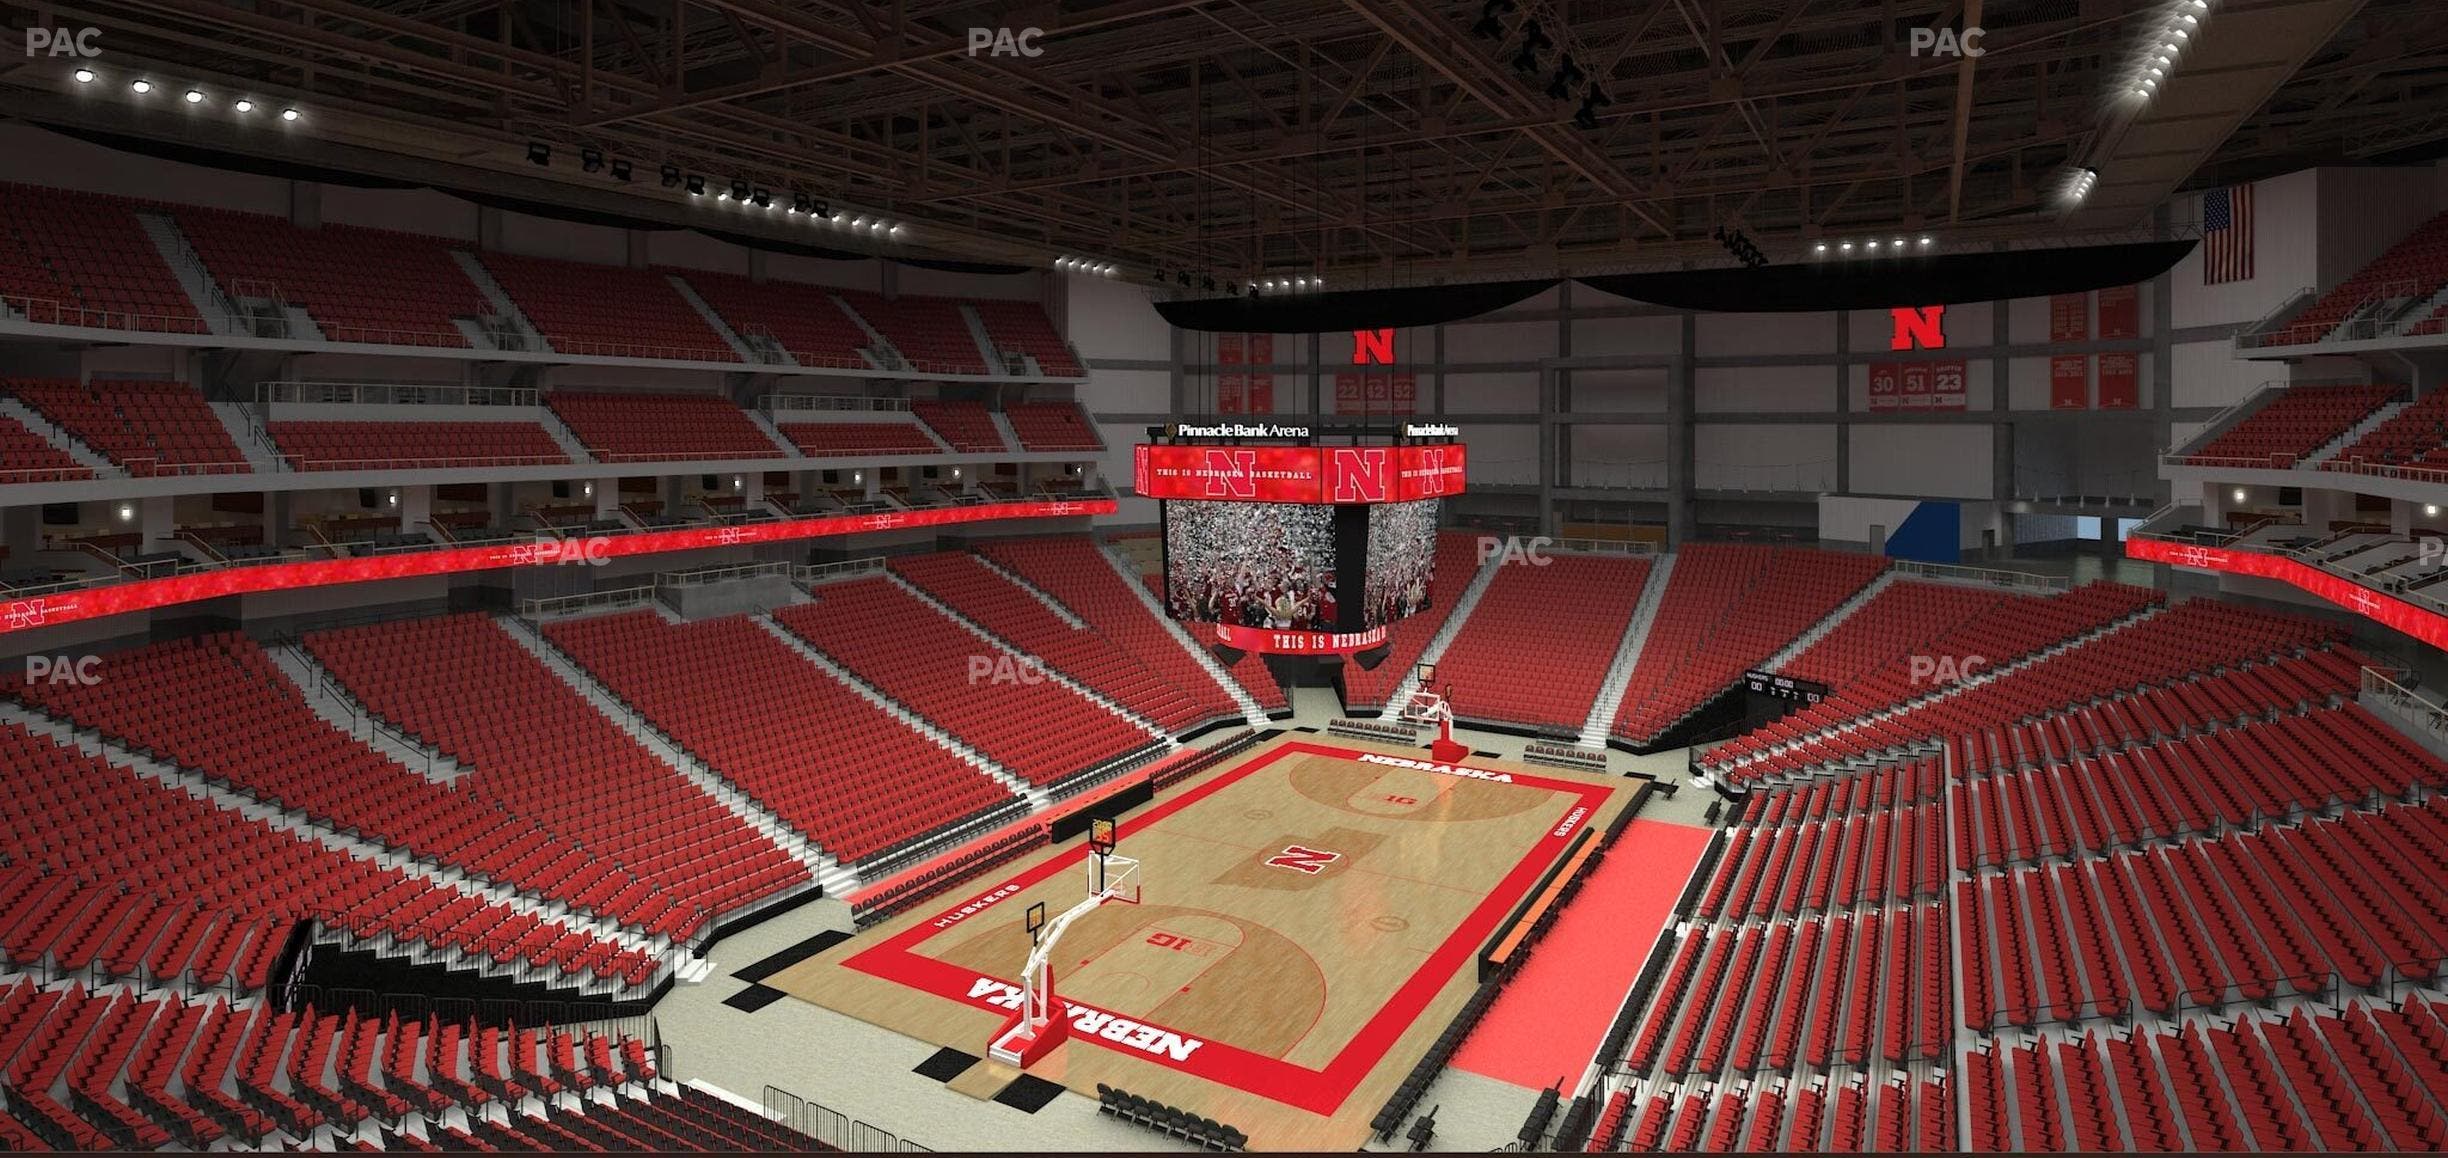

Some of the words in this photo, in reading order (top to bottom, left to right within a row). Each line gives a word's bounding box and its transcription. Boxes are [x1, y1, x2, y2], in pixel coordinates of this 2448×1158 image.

[1891, 305, 1944, 350] N
[1353, 328, 1395, 364] N
[1338, 385, 1359, 399] 22
[1873, 376, 1894, 392] 30
[1907, 375, 1926, 391] 51
[1937, 374, 1962, 391] 23
[1178, 424, 1233, 437] Pinnacle
[1233, 424, 1268, 437] Bank
[1268, 425, 1309, 437] Arena
[1157, 468, 1178, 477] THIS
[1206, 450, 1256, 497] N
[1335, 450, 1385, 501] N
[11, 599, 45, 629] N
[1273, 633, 1305, 649] THIS
[1312, 634, 1325, 649] IS
[1332, 628, 1381, 648] NEBRASKA
[1751, 681, 1762, 691] 00
[1807, 692, 1819, 703] 00
[1357, 753, 1513, 783] NEBRASKA
[1264, 845, 1341, 874] N
[934, 884, 1020, 928] HUSKERS
